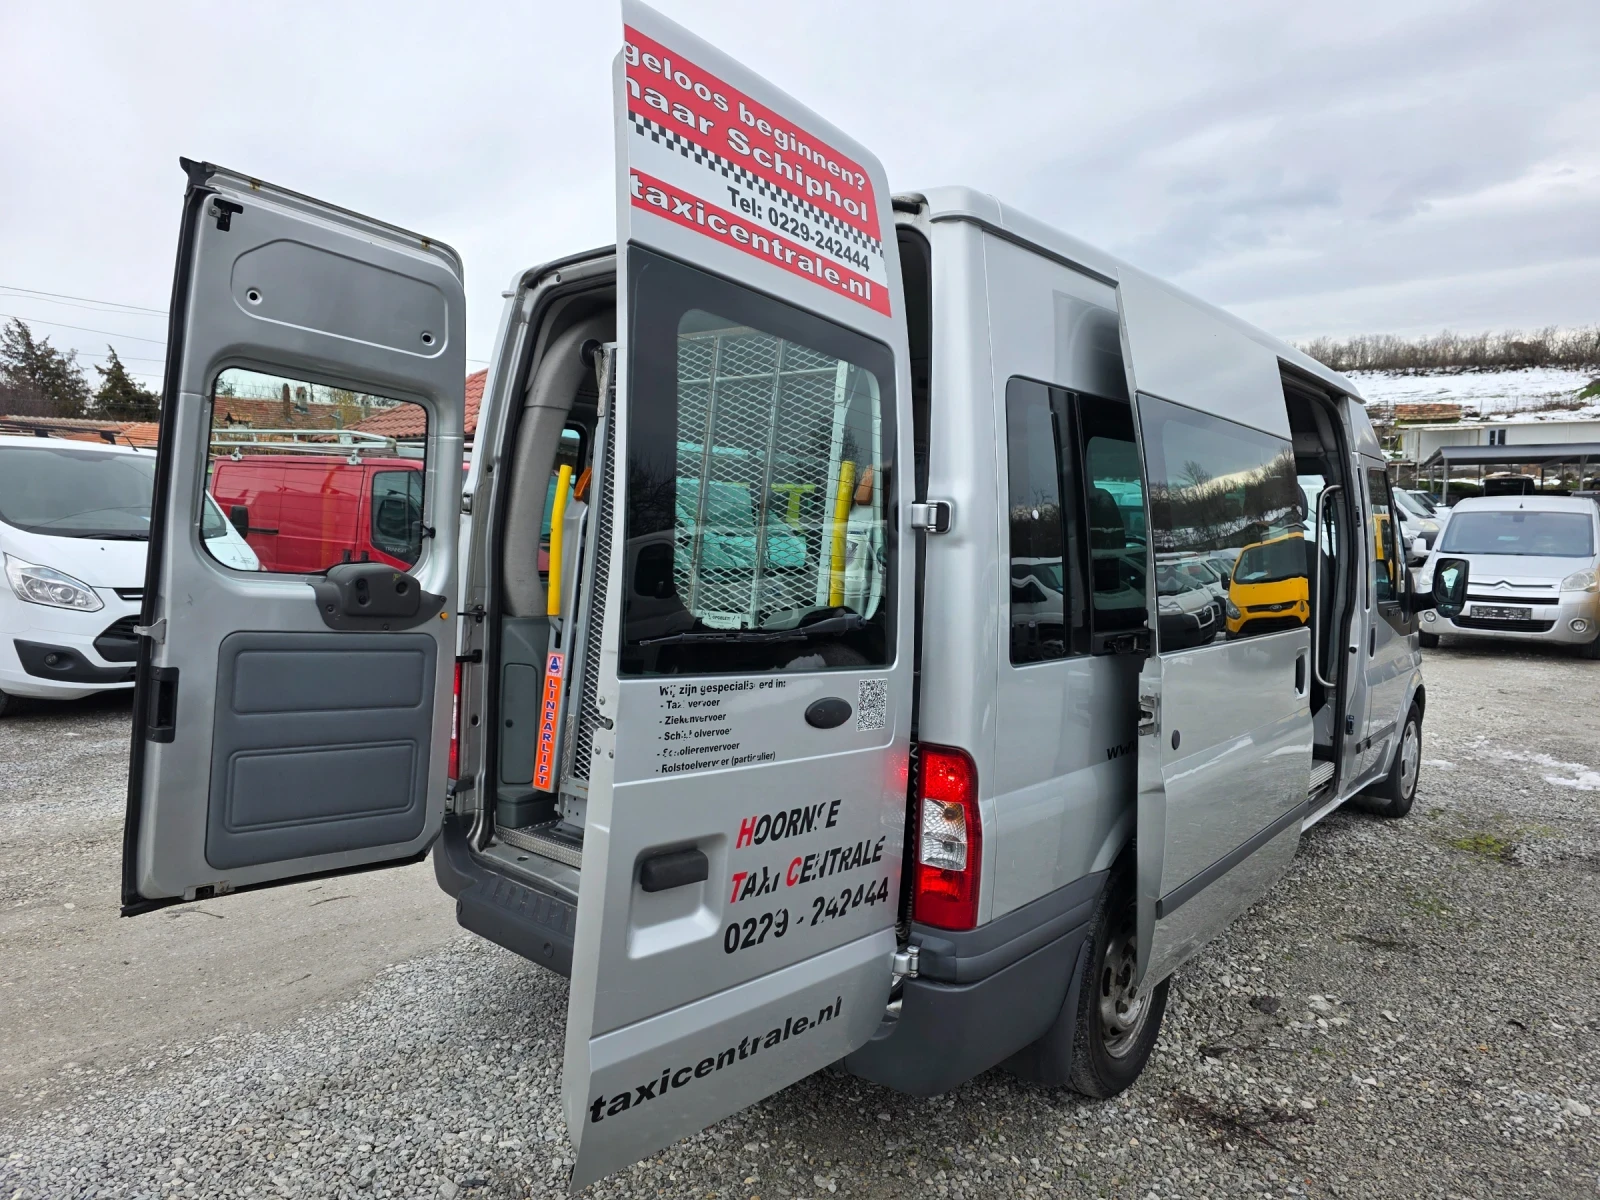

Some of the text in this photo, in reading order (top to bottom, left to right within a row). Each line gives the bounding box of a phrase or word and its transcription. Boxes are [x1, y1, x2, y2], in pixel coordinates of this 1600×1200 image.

[624, 40, 866, 192] geloos beginnen?
[727, 127, 868, 223] Schiphol
[630, 174, 872, 301] taxicentrale.nl
[727, 185, 870, 273] Tel: 0229-242444
[537, 679, 557, 786] LINEARLIFT
[679, 684, 698, 697] zijn
[776, 679, 787, 689] in:
[724, 907, 789, 954] 0229
[589, 995, 842, 1123] taxicentrale.nl
